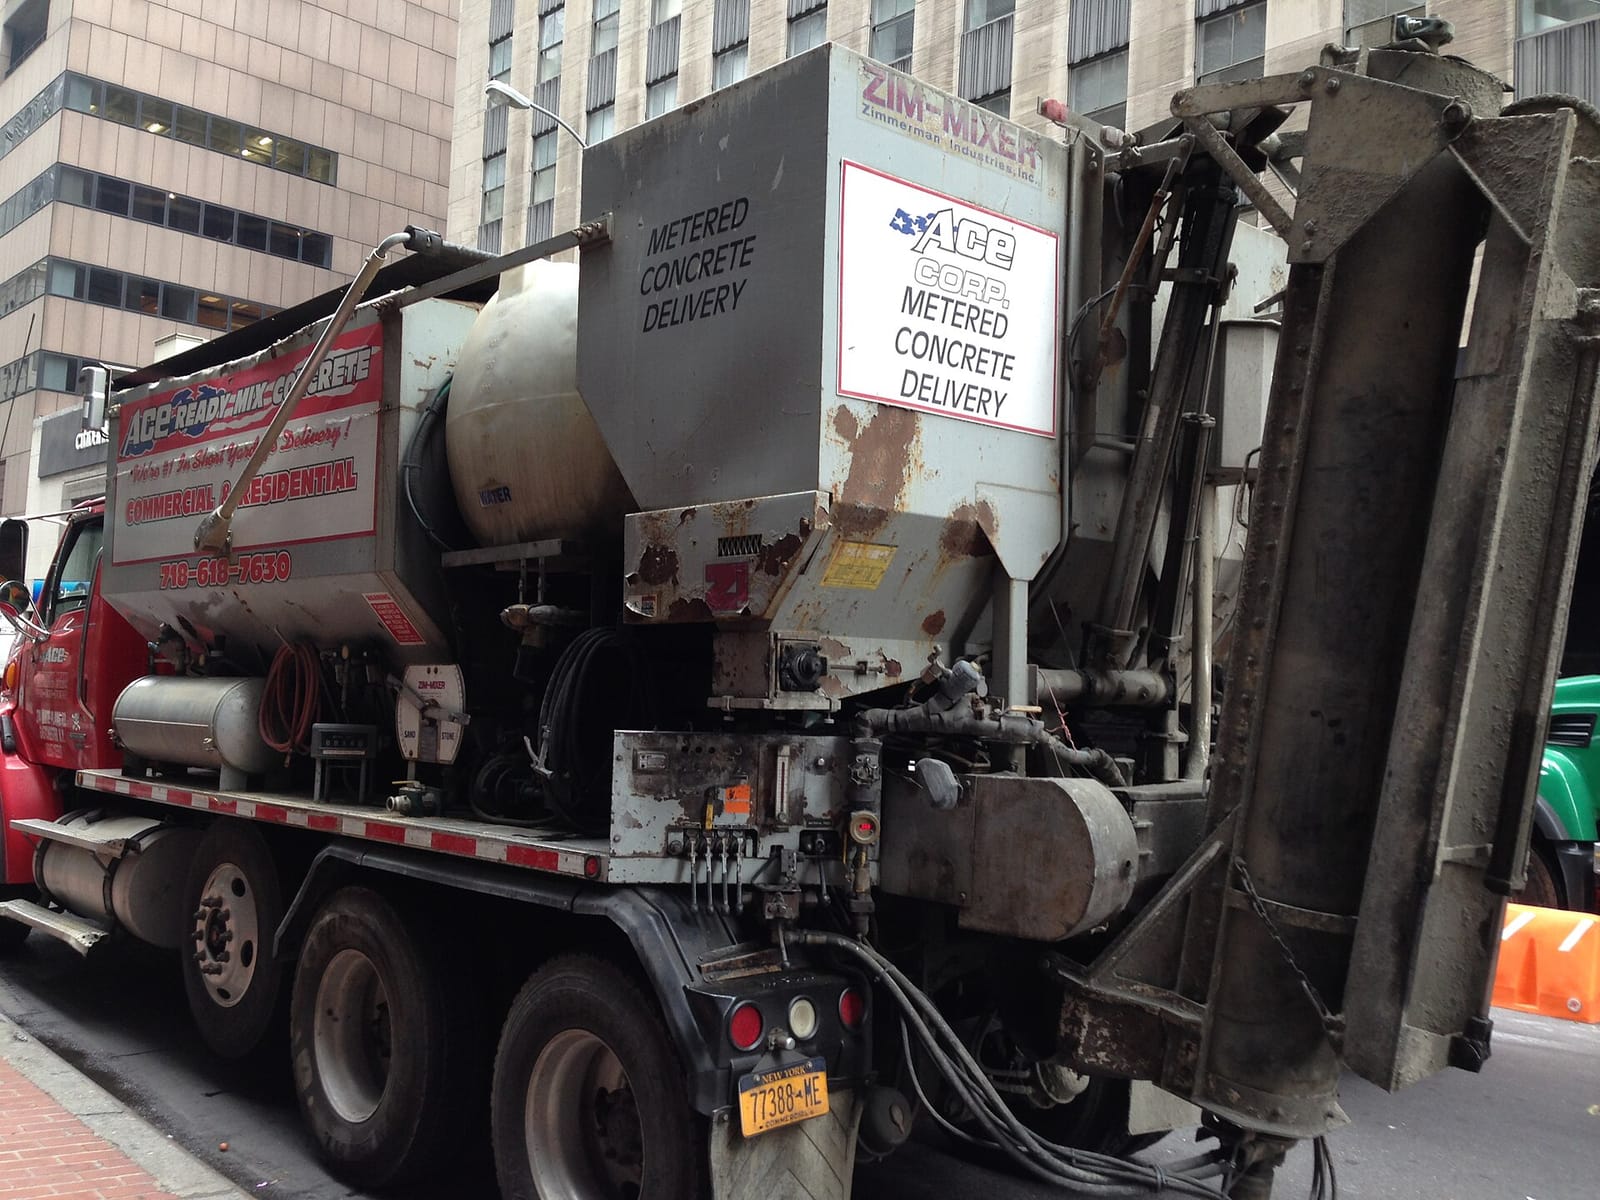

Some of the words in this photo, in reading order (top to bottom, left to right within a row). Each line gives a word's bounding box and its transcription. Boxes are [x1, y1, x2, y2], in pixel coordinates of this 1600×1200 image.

[863, 63, 1039, 169] ZIM-MIXER
[862, 103, 940, 144] Zimmerman
[1018, 167, 1038, 184] Inc.
[647, 197, 749, 256] METERED
[640, 235, 757, 295] CONCRETE
[914, 257, 1010, 309] CORP.
[643, 279, 748, 333] DELIVERY
[901, 286, 1008, 339] METERED
[895, 327, 1015, 381] CONCRETE
[174, 347, 372, 429] READY-MIX-COCRETE
[900, 369, 1008, 418] DELIVERY
[176, 452, 190, 473] In
[192, 446, 224, 469] Short
[126, 484, 215, 526] COMMERCIAL
[479, 486, 512, 505] WATER
[160, 551, 292, 589] 718-618-7630
[762, 1071, 783, 1084] NEW
[784, 1065, 806, 1078] YORK
